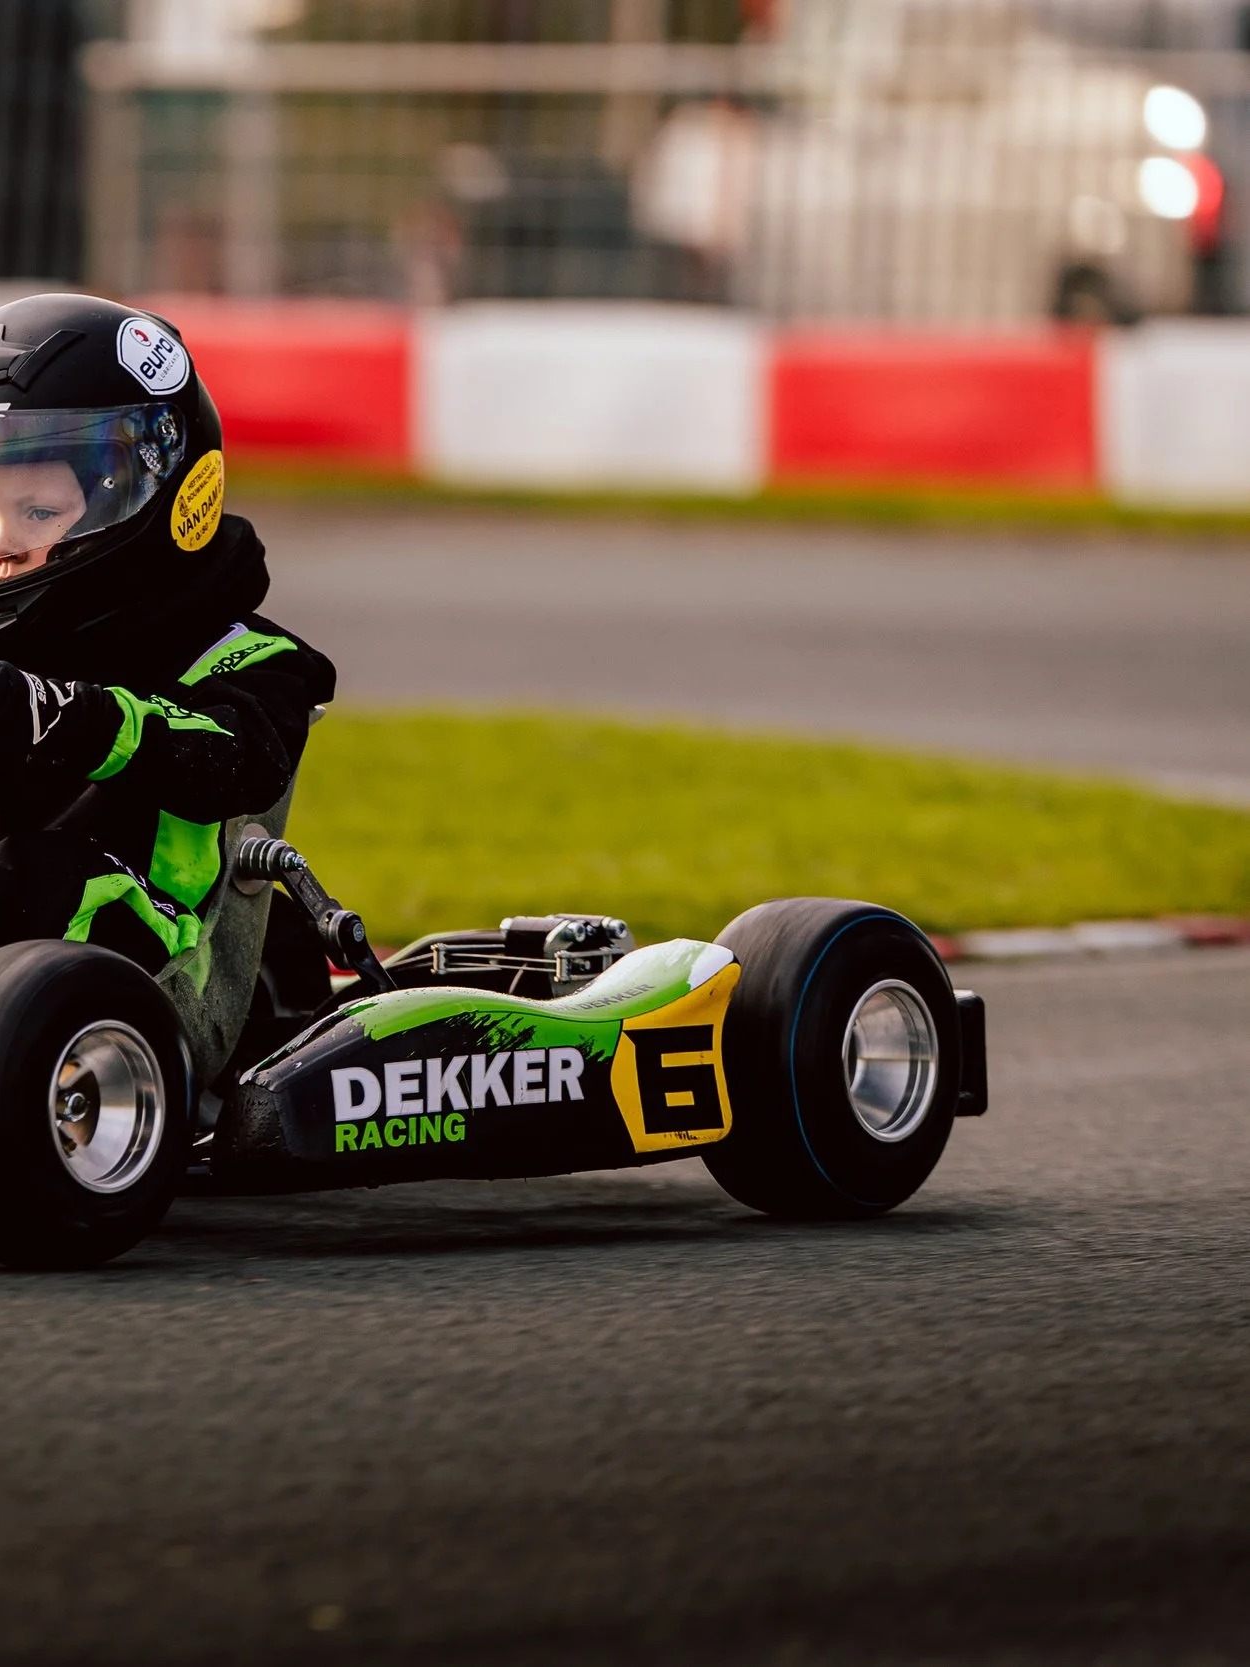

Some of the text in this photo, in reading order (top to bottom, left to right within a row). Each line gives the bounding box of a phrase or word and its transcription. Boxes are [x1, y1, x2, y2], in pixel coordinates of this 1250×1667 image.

[177, 509, 200, 538] VAN
[578, 984, 656, 1011] DEKKER
[331, 1047, 585, 1122] DEKKER
[623, 1024, 726, 1135] 6
[335, 1113, 466, 1152] RACING
